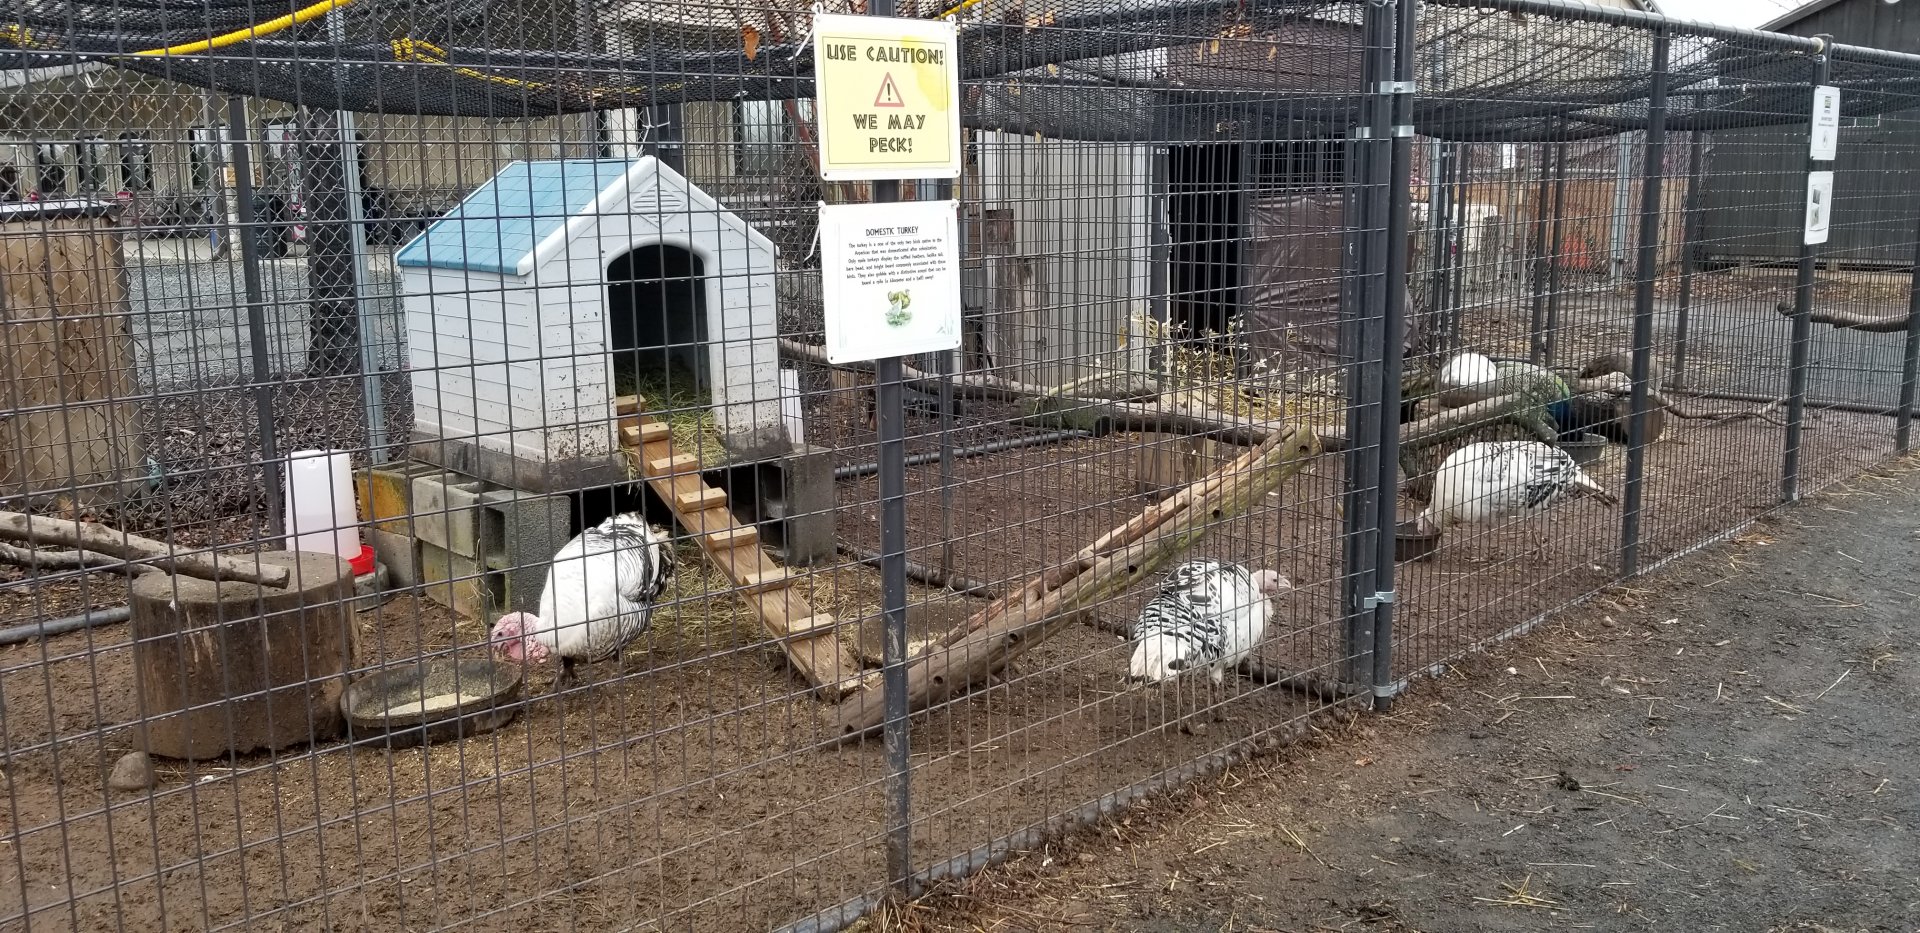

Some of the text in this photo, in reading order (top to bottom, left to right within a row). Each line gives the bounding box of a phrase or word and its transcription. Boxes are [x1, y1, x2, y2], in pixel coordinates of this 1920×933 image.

[827, 44, 943, 65] USE CAUTION!
[853, 114, 926, 129] WE MAY
[870, 138, 912, 153] PECK!
[866, 226, 918, 236] DOMESTIC TURKEY
